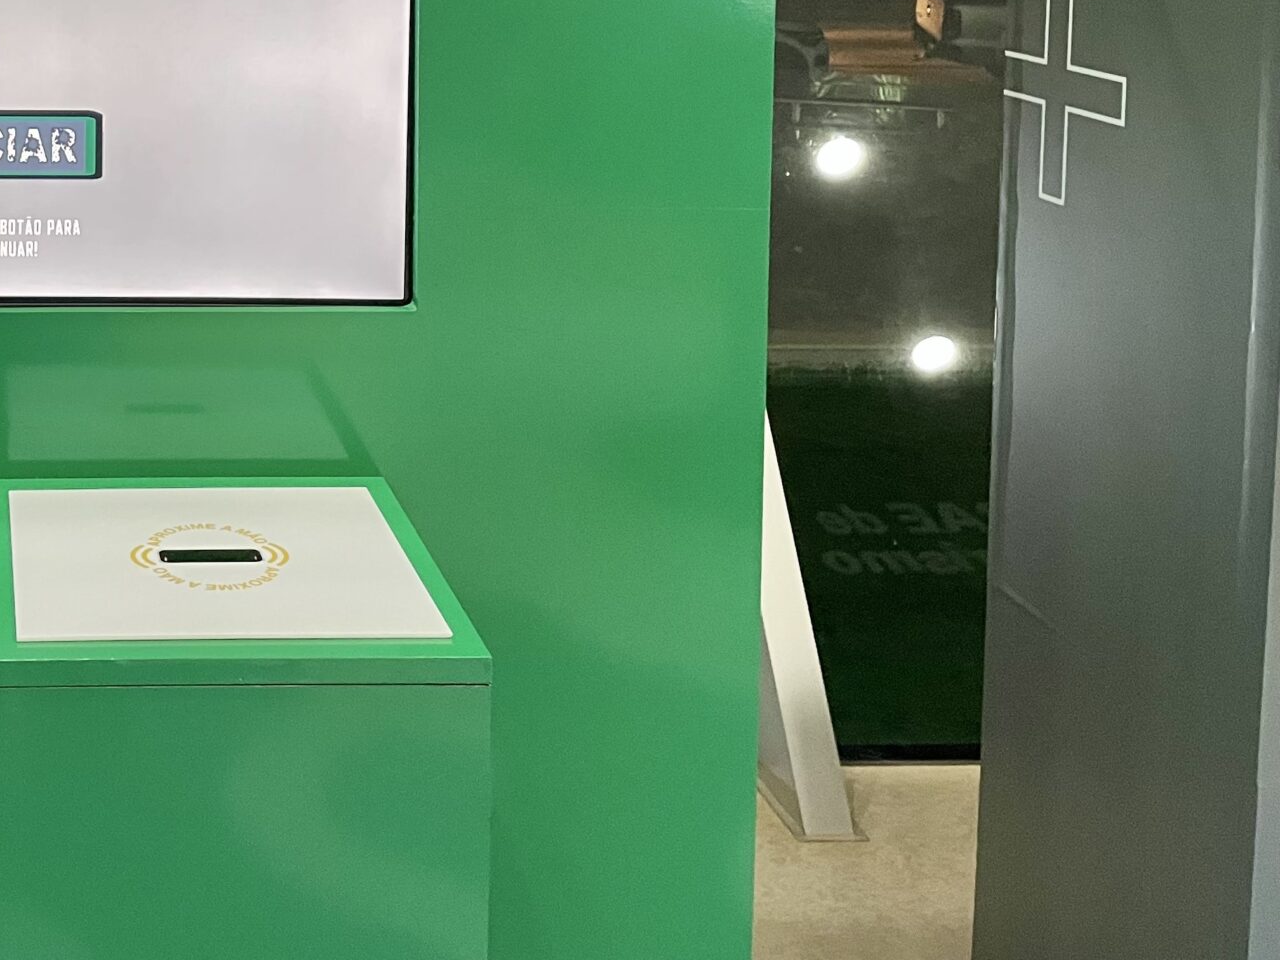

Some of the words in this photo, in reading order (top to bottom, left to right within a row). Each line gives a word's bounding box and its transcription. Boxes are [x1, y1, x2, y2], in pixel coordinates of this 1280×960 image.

[0, 216, 42, 236] BOTÃO
[46, 218, 81, 236] PARA
[147, 523, 216, 547] APROXIME
[205, 566, 280, 591] APROXIME
